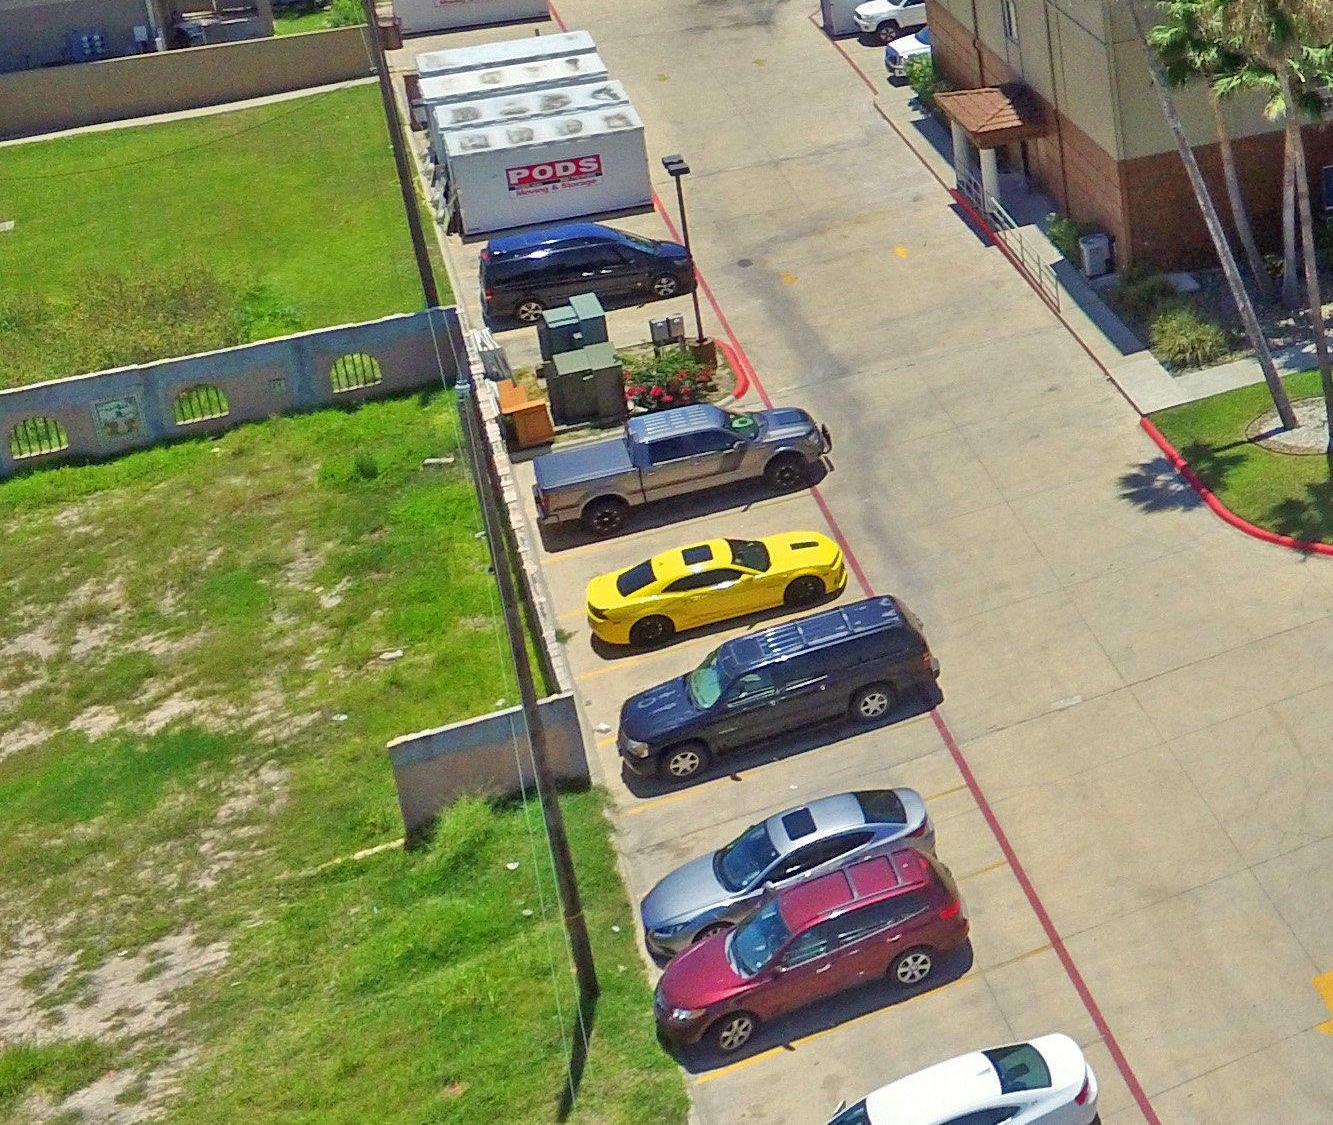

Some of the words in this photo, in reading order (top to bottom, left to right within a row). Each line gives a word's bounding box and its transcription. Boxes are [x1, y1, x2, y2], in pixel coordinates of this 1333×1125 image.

[508, 158, 598, 185] PODS
[516, 186, 550, 196] Moving
[561, 179, 598, 189] Storage
